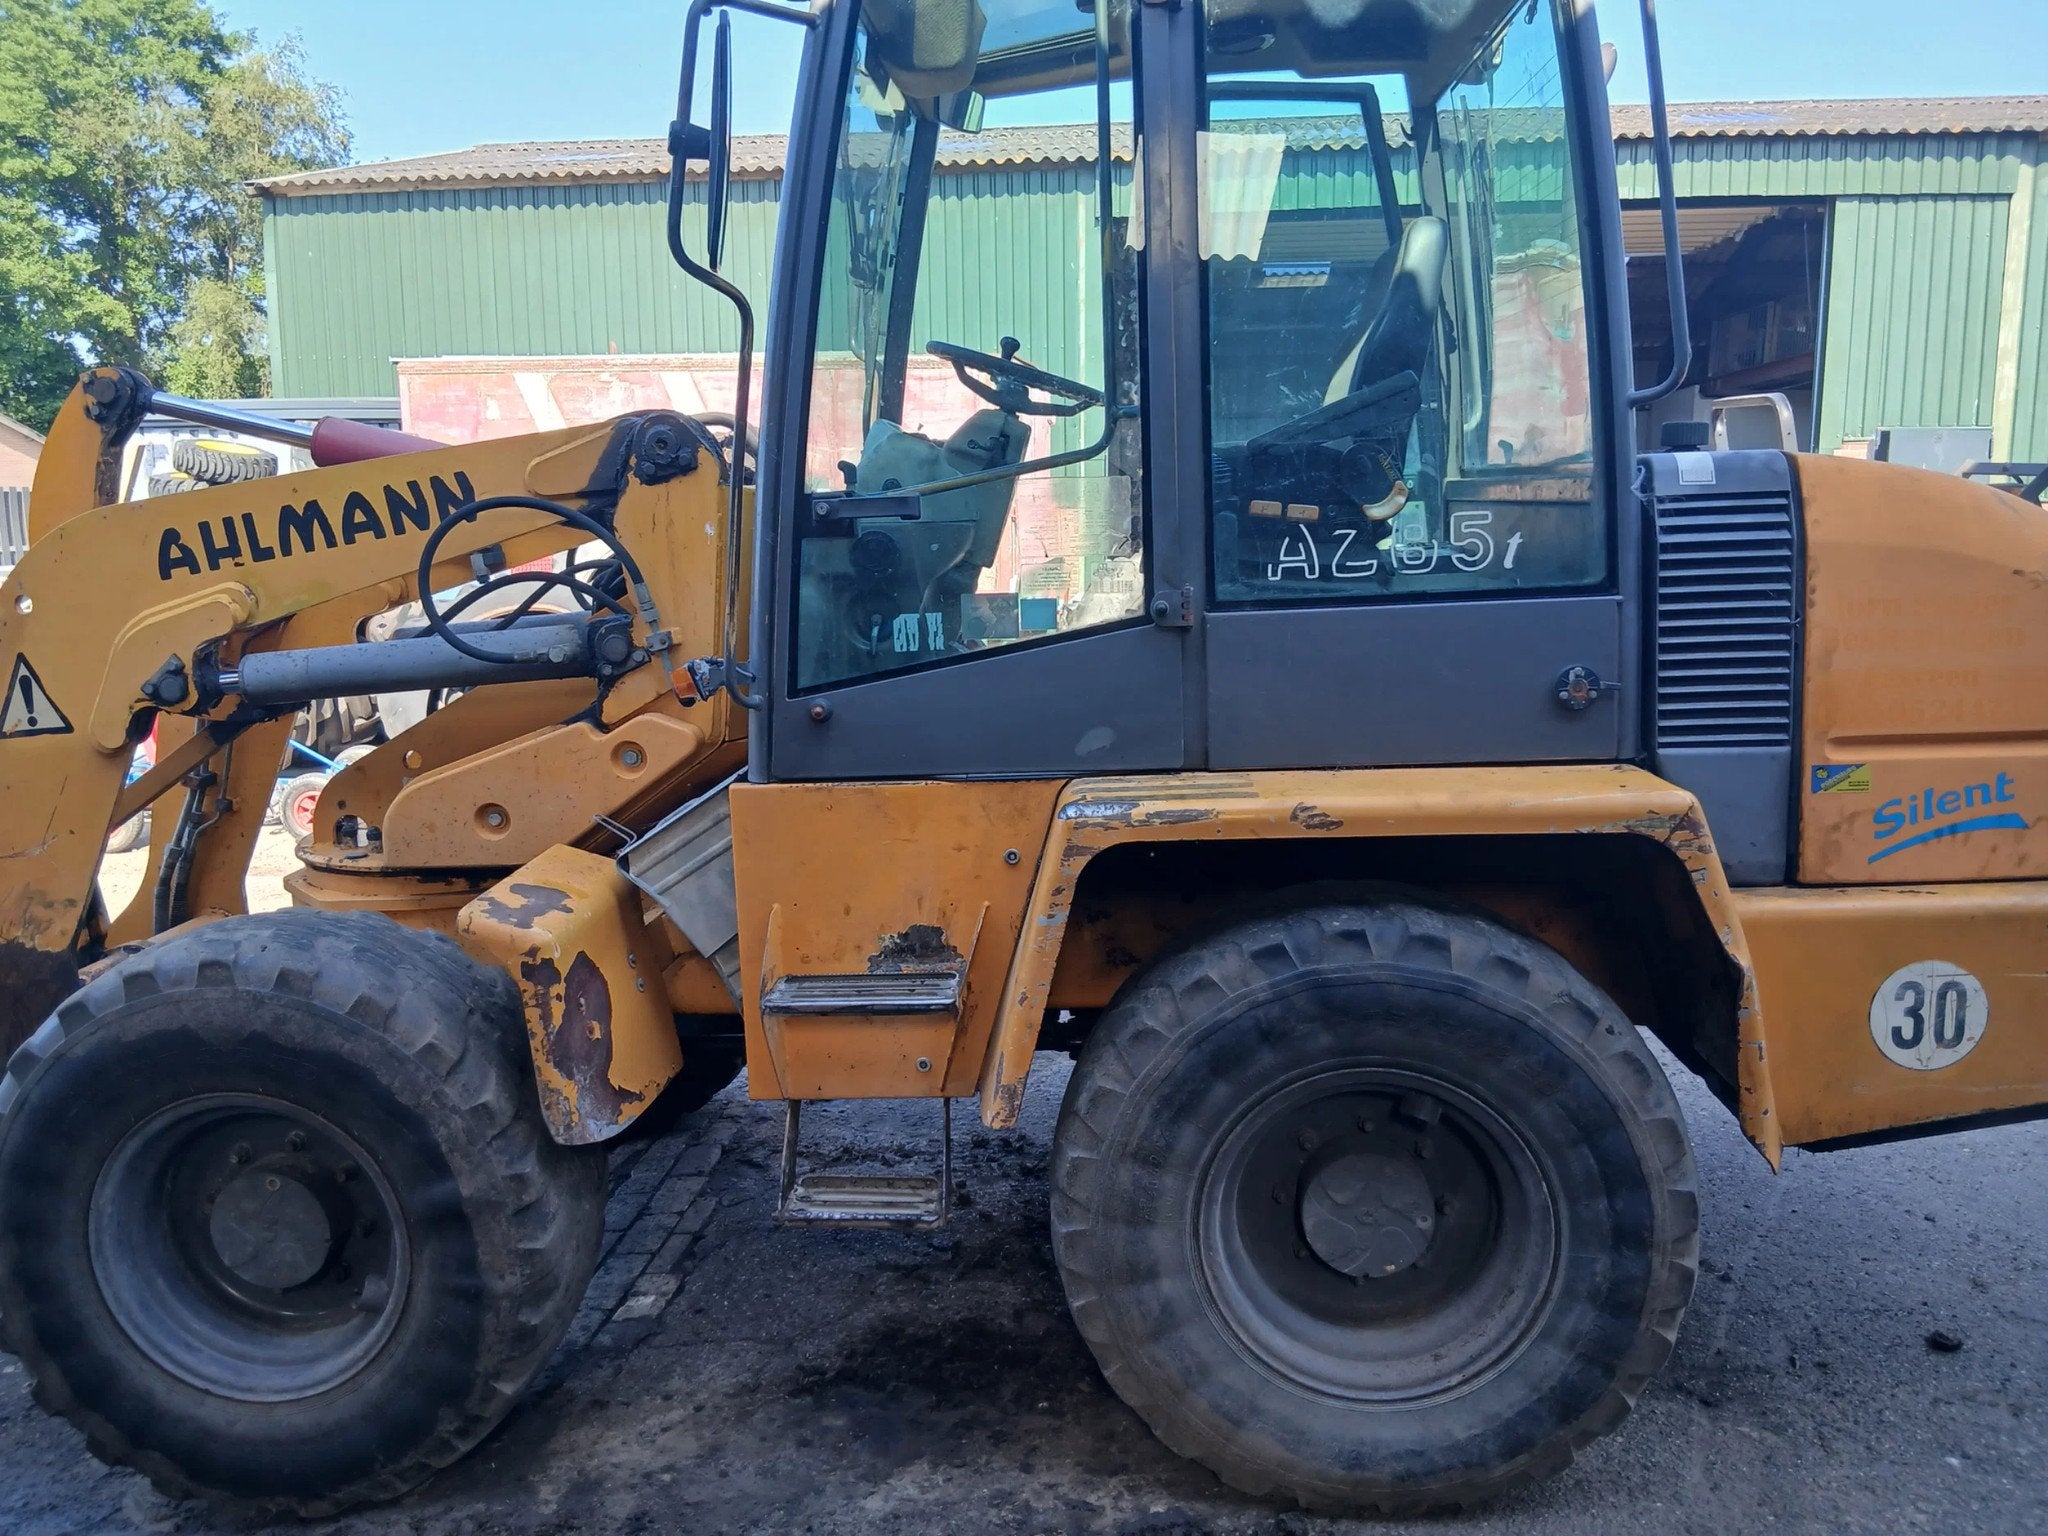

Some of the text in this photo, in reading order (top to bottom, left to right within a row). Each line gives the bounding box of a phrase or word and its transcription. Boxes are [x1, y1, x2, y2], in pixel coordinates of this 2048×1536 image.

[158, 471, 477, 580] AHLMANN
[1873, 771, 2015, 839] Silent
[1891, 980, 1967, 1050] 30
